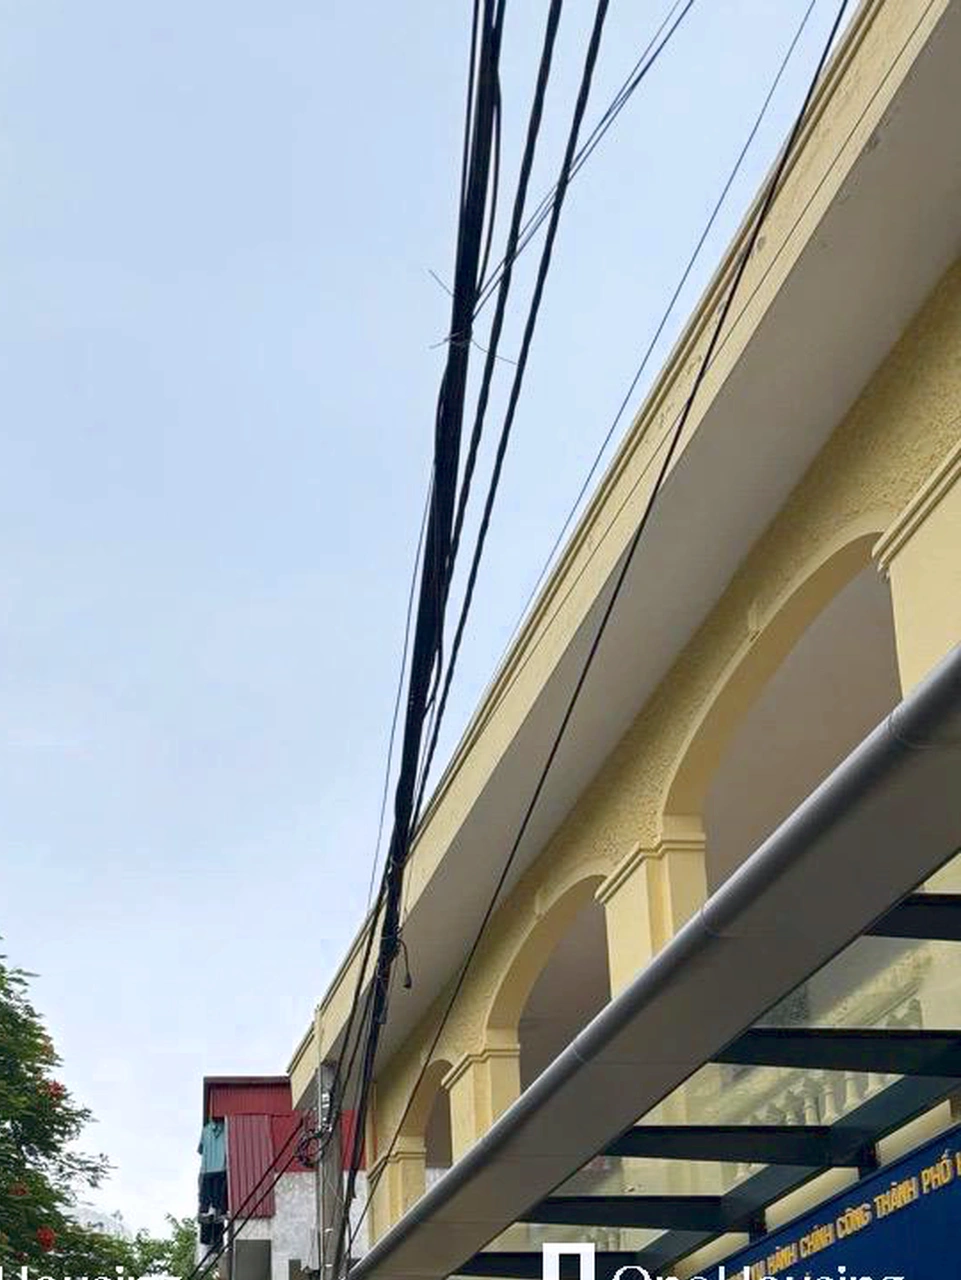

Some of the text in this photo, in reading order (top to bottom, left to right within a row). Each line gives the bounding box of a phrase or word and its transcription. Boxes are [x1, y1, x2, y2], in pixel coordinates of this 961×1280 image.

[836, 1203, 873, 1239] CÔNG
[874, 1177, 920, 1219] THÀNH
[921, 1149, 954, 1194] PHỐ
